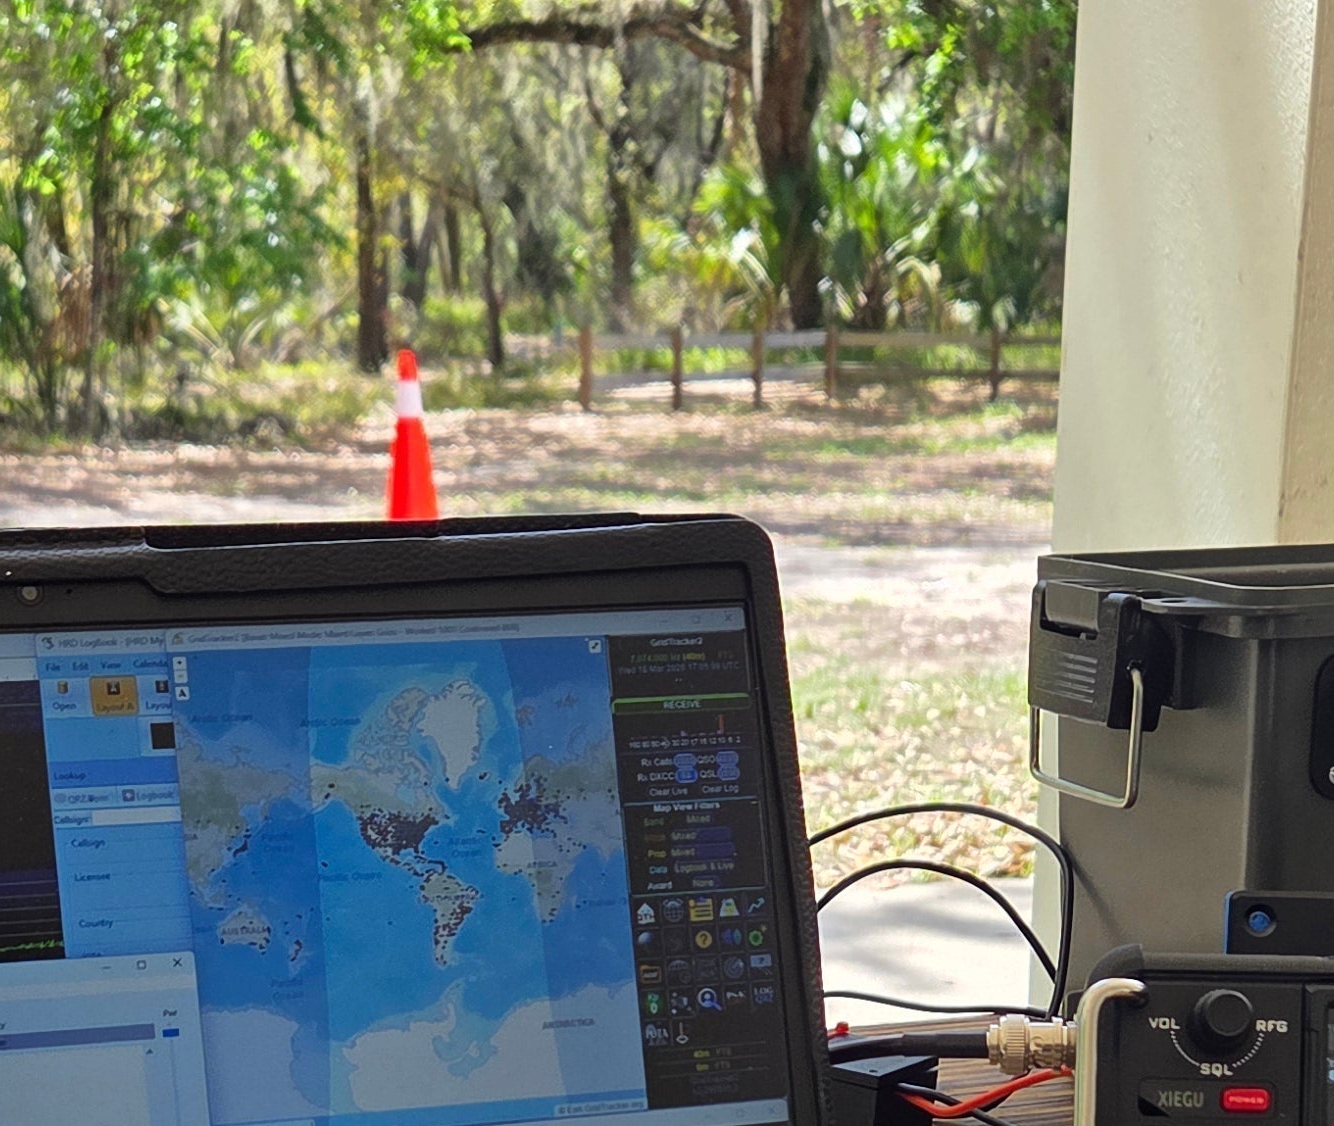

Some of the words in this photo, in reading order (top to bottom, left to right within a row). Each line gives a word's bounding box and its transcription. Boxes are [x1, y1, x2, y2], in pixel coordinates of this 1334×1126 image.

[1149, 1017, 1180, 1030] VOL
[1256, 1020, 1288, 1033] RFG
[1199, 1063, 1233, 1077] SQL
[1157, 1090, 1204, 1108] XIEGU
